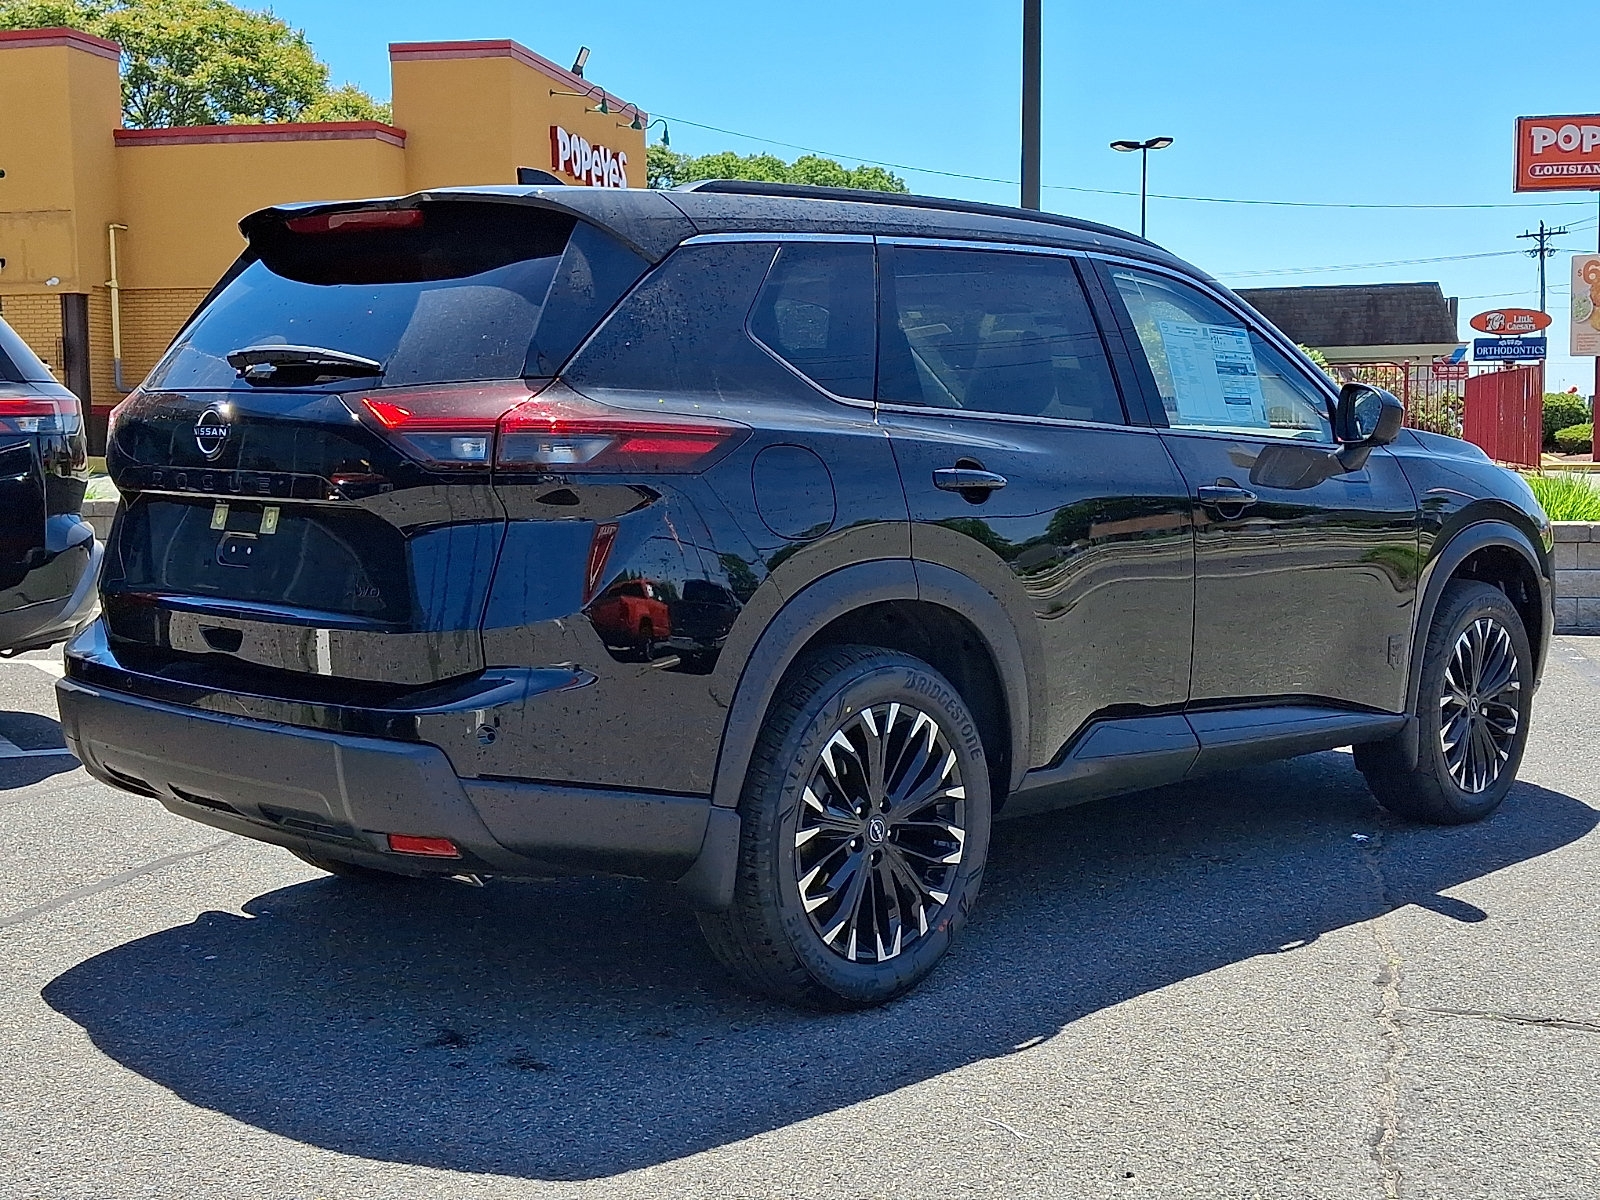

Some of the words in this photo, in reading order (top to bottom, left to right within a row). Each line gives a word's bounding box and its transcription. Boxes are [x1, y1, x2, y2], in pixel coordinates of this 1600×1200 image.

[1513, 314, 1534, 323] Little
[1507, 322, 1536, 331] Caesars
[1476, 345, 1545, 356] ORTHODONTICS
[193, 427, 227, 437] NISSAN
[151, 470, 271, 495] ROGUE
[902, 670, 983, 761] BRIDGESTONE
